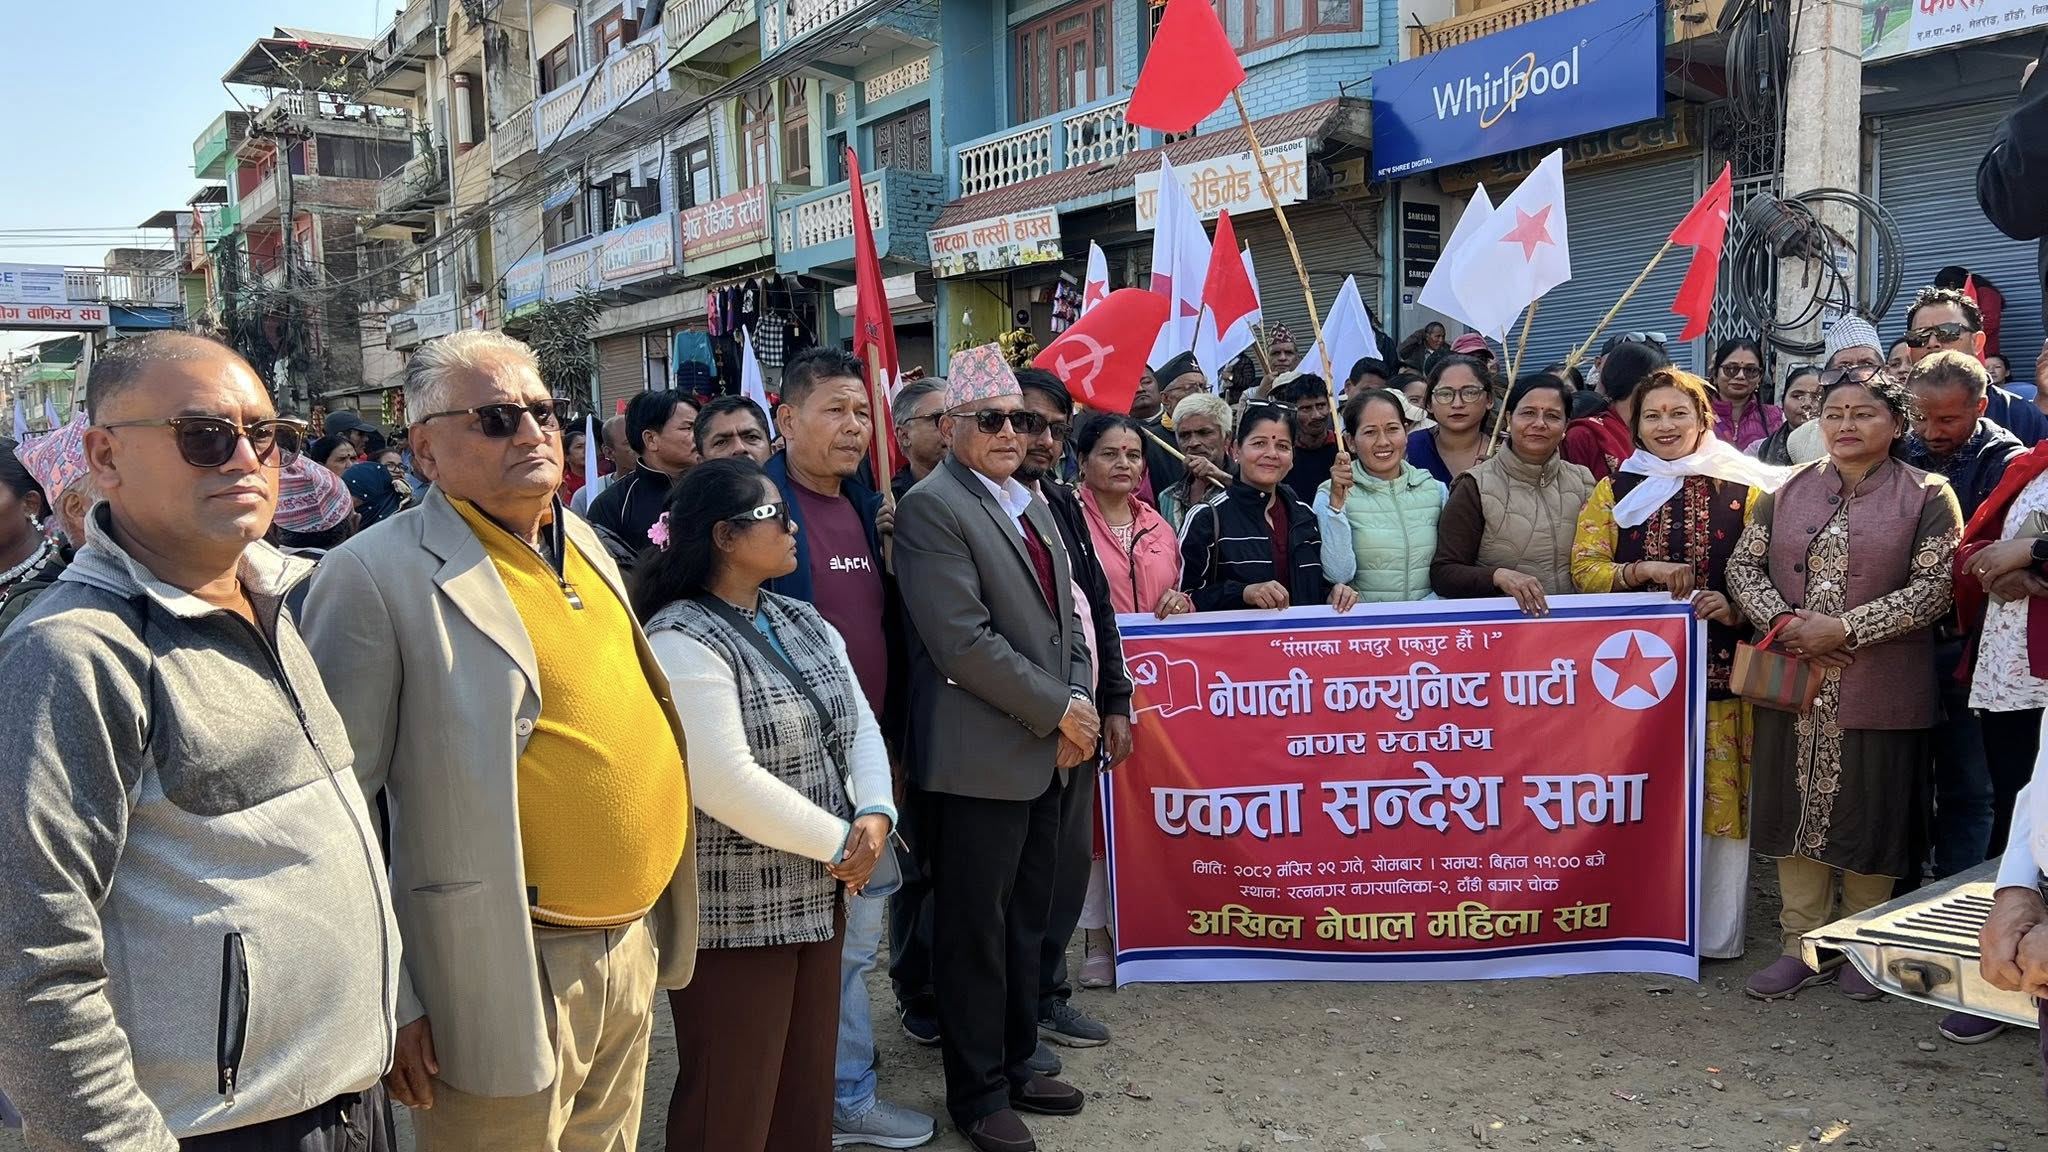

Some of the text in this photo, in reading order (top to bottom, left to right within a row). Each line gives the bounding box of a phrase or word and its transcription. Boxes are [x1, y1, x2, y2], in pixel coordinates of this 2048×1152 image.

[1432, 45, 1579, 121] Whirlpool
[1263, 140, 1303, 157] ४५१४६०७८
[1378, 157, 1433, 176] NEW SHREE DIGITAL
[1190, 165, 1250, 211] रेडिमेड
[703, 201, 735, 237] रेडिमेड
[971, 217, 1010, 247] लस्सी
[1013, 215, 1052, 241] हाउस
[1408, 212, 1435, 222] SAMSUNG
[1408, 270, 1430, 278] SAMSU
[28, 306, 72, 320] वाणिज्य
[80, 308, 101, 320] संघ
[1270, 636, 1342, 657] “संसारका
[1348, 638, 1393, 658] मजदुर
[1398, 636, 1449, 656] एकजुट
[1208, 658, 1578, 721] नेपाली कम्युनिष्ट पार्टी
[1286, 723, 1493, 757] नगर स्तरीय
[1151, 761, 1648, 838] एकता सन्देश सभा
[1233, 865, 1272, 878] २०८२
[1276, 861, 1313, 877] मंसिर
[1317, 861, 1336, 875] २९
[1340, 855, 1366, 875] गते,
[1371, 855, 1422, 872] सोमबार
[1489, 853, 1529, 870] बिहान
[1533, 856, 1581, 869] ११:००
[1585, 850, 1607, 867] बजे
[1287, 885, 1346, 899] रत्ननगर
[1487, 879, 1522, 892] बजार
[1527, 874, 1560, 892] चोक
[1187, 900, 1611, 941] अखिल नेपाल महिला संघ
